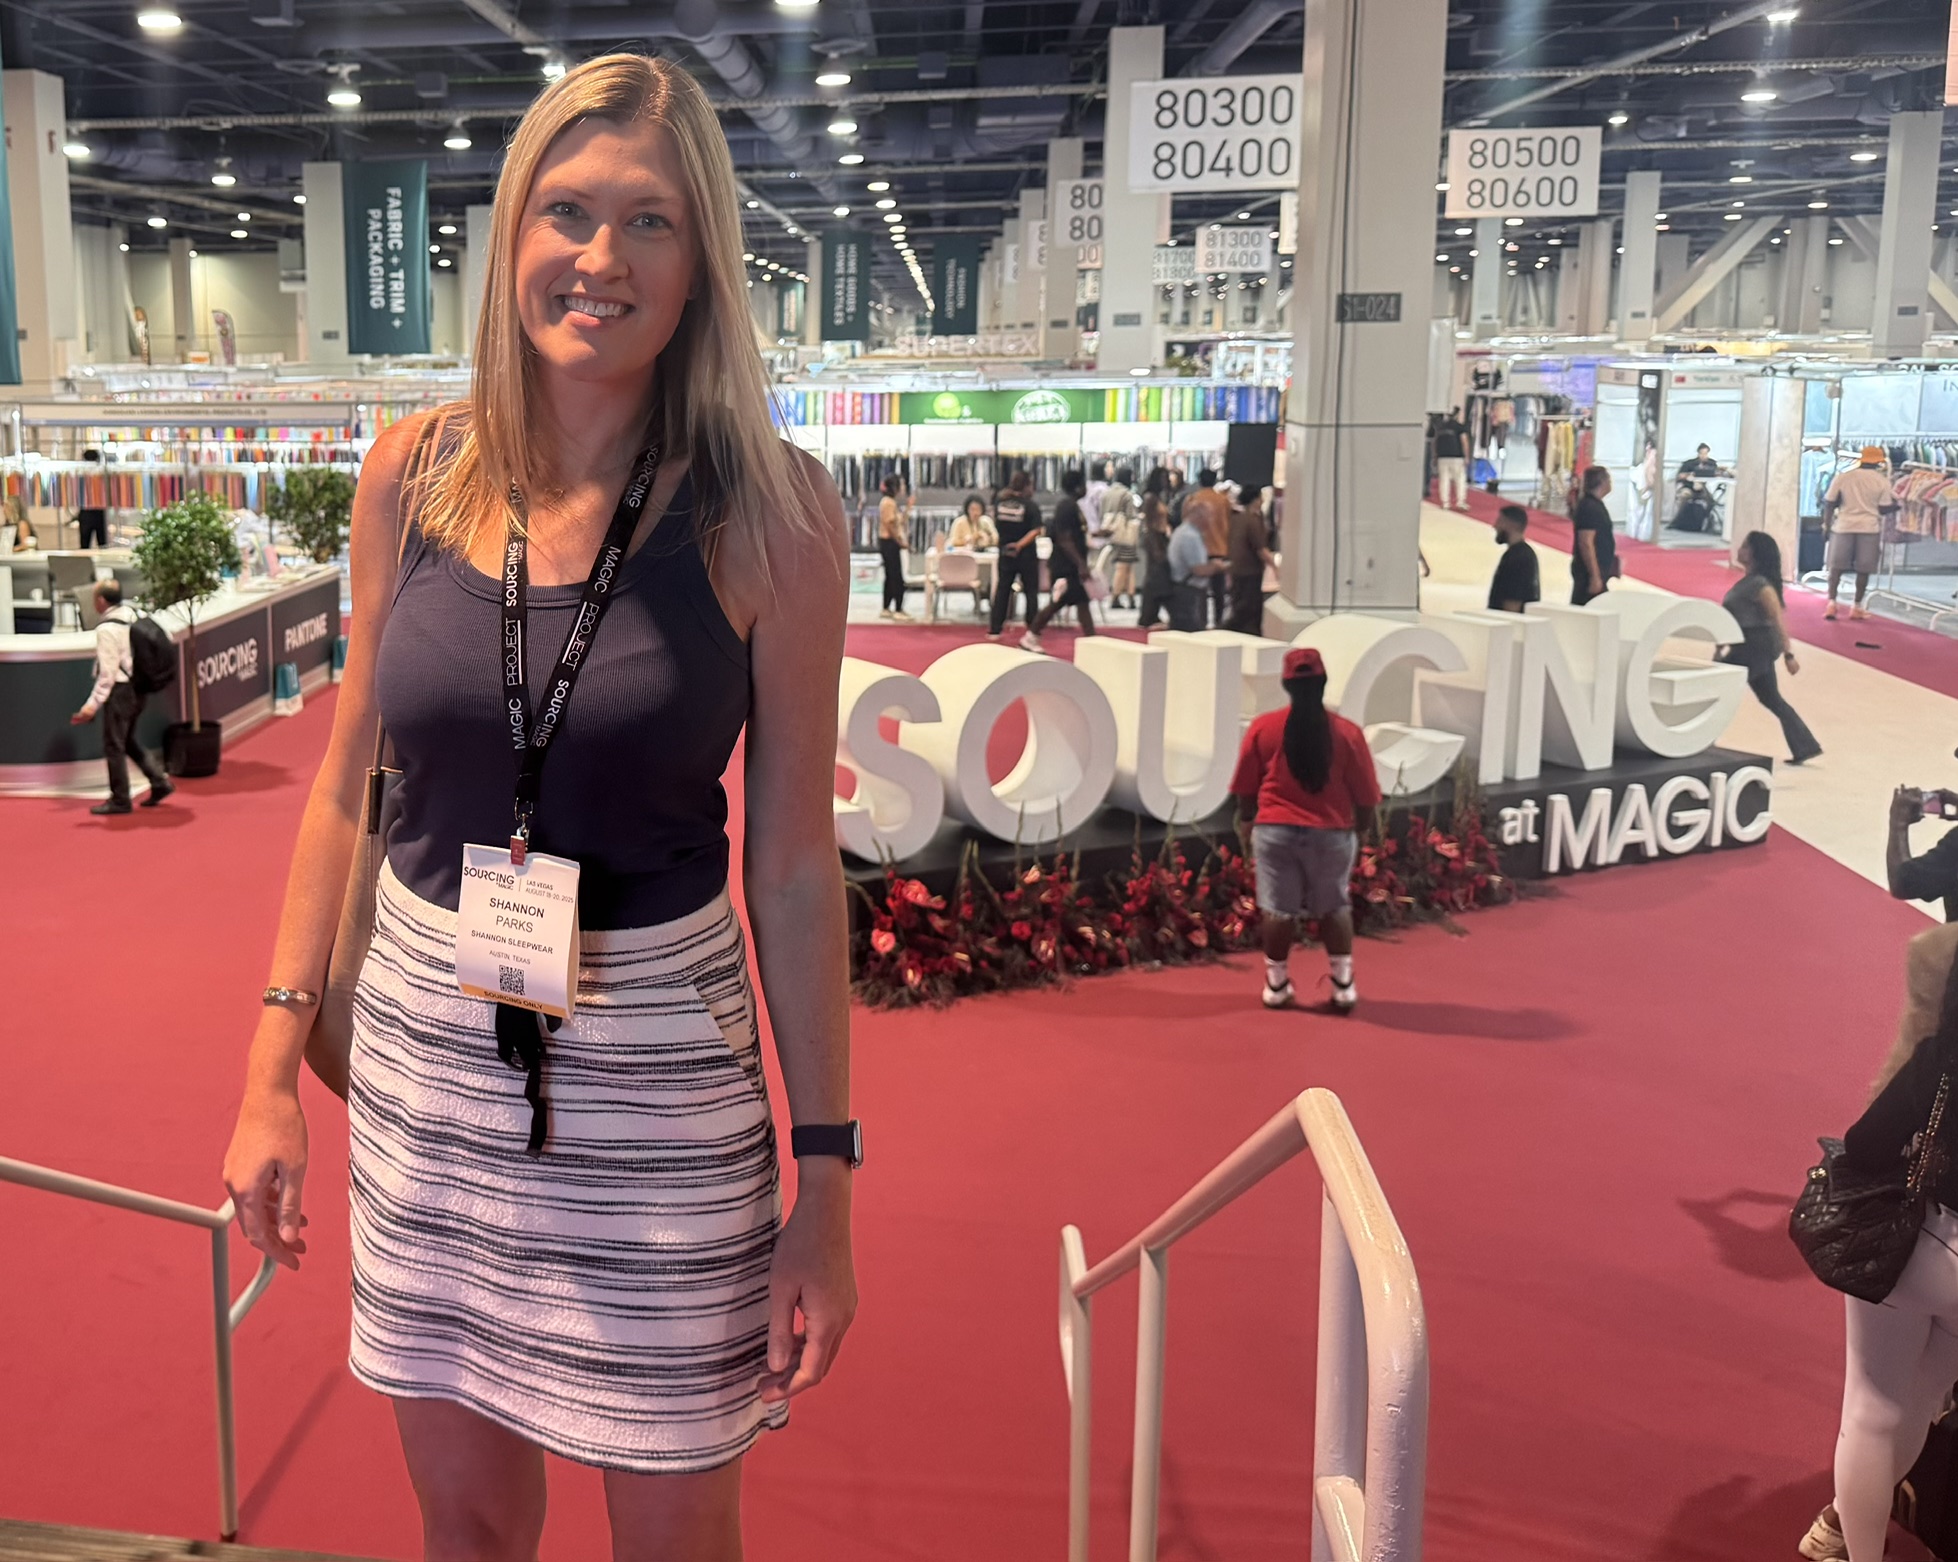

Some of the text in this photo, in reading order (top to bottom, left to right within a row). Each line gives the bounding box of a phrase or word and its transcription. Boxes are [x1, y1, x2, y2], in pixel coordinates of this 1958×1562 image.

[1154, 85, 1294, 129] 80300
[1152, 137, 1291, 180] 80400
[1468, 135, 1581, 169] 80500
[1466, 176, 1579, 209] 80600
[386, 187, 403, 250] FABRIC
[1206, 231, 1262, 248] 81300
[367, 208, 385, 310] PACKAGING
[1204, 250, 1261, 268] 81400
[389, 269, 405, 313] TRIM
[894, 334, 1038, 357] SUPERTEX
[629, 445, 659, 508] SOURCING
[506, 542, 518, 607] SOURCING
[594, 546, 621, 593] MAGIC
[285, 612, 328, 653] PANTONE
[506, 618, 518, 686] PROJECT
[566, 602, 600, 671] PROJECT
[197, 637, 258, 689] SOURCING
[509, 698, 526, 749] MAGIC
[536, 679, 570, 748] SOURCING
[833, 592, 1748, 863] SOUCING
[1500, 765, 1773, 873] at MAGIC
[463, 866, 515, 885] SOURCING
[525, 888, 545, 897] AUGUST
[526, 879, 553, 890] LAS VEGAS
[489, 897, 545, 918] SHANNON
[495, 915, 534, 933] PARKS
[471, 930, 553, 954] SHANNON SLEEPWEAR
[489, 950, 531, 965] AUSTIN, TEXAS
[483, 991, 543, 1010] SOURCING ONLY
